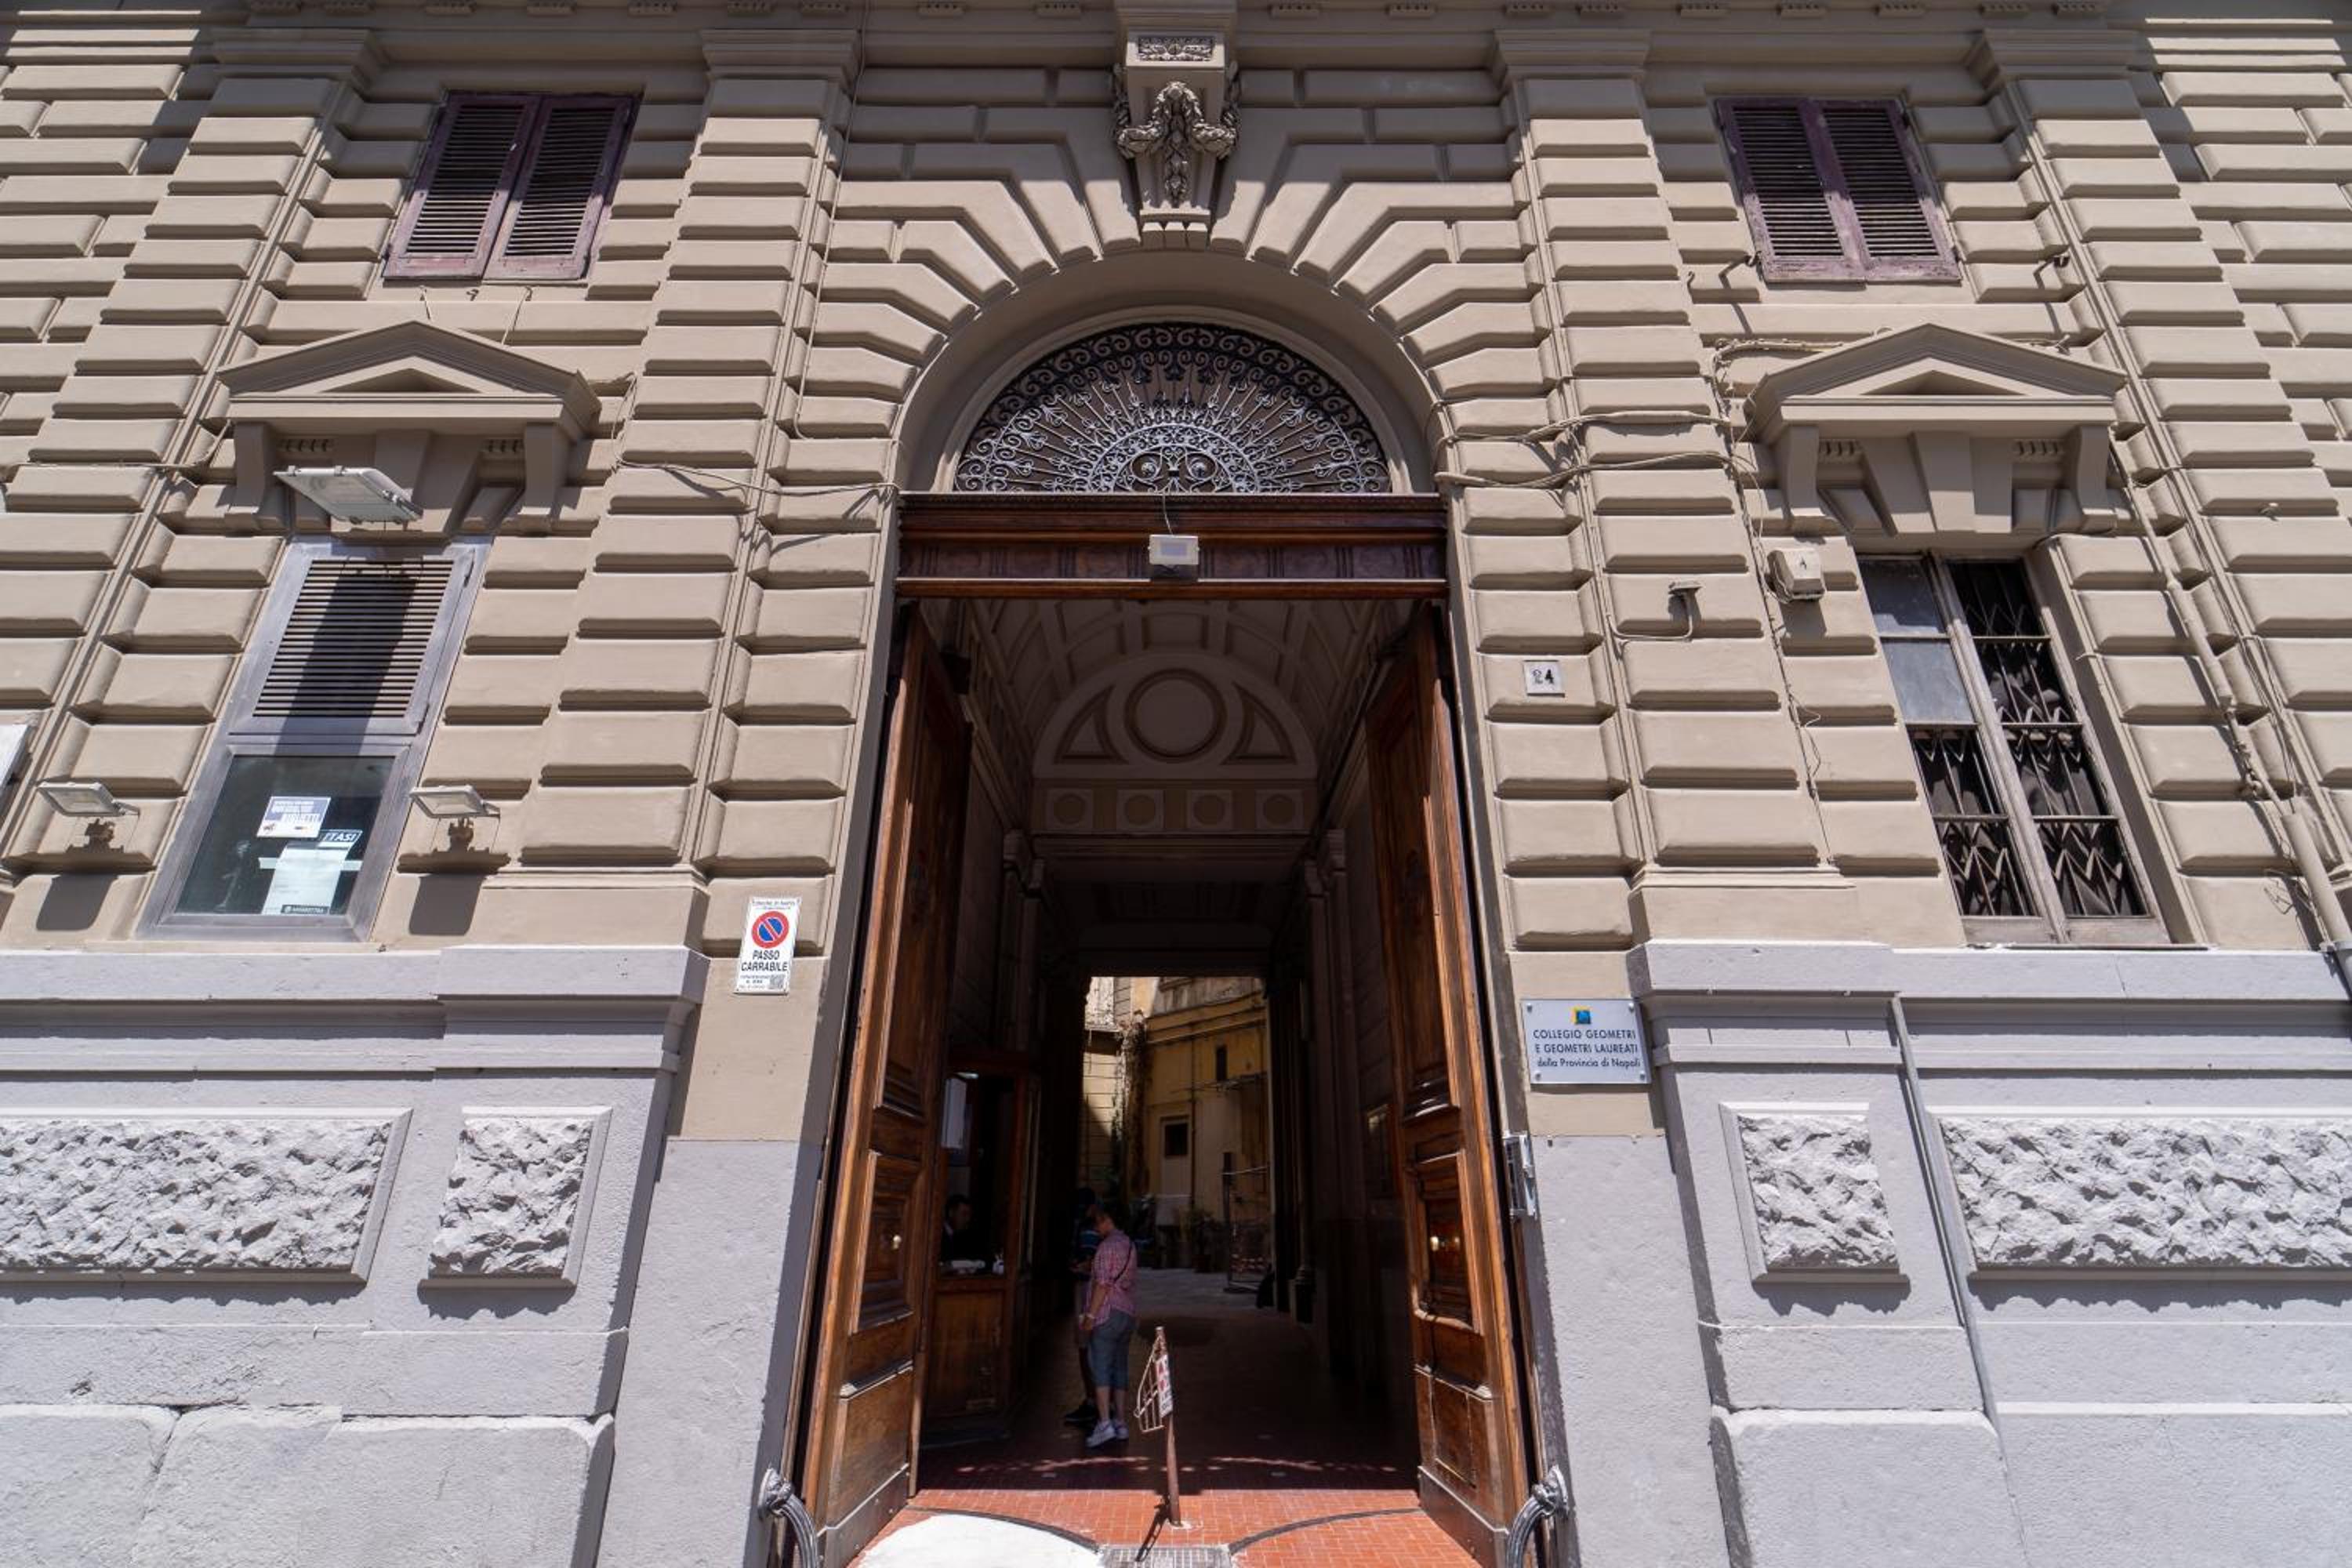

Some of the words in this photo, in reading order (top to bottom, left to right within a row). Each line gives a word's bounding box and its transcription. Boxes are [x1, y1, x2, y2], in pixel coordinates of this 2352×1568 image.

[753, 949, 780, 960] PASSO
[741, 962, 788, 972] CARRABILE
[1533, 1029, 1582, 1040] COLLEGIO
[1585, 1029, 1636, 1040] GEOMETRI
[1534, 1044, 1541, 1054] E
[1544, 1044, 1592, 1054] GEOMETRI
[1594, 1044, 1639, 1054] LAUREATI
[1537, 1058, 1559, 1067] della
[1560, 1058, 1599, 1067] Provincia
[1600, 1058, 1610, 1067] di
[1611, 1058, 1641, 1069] Napoli
